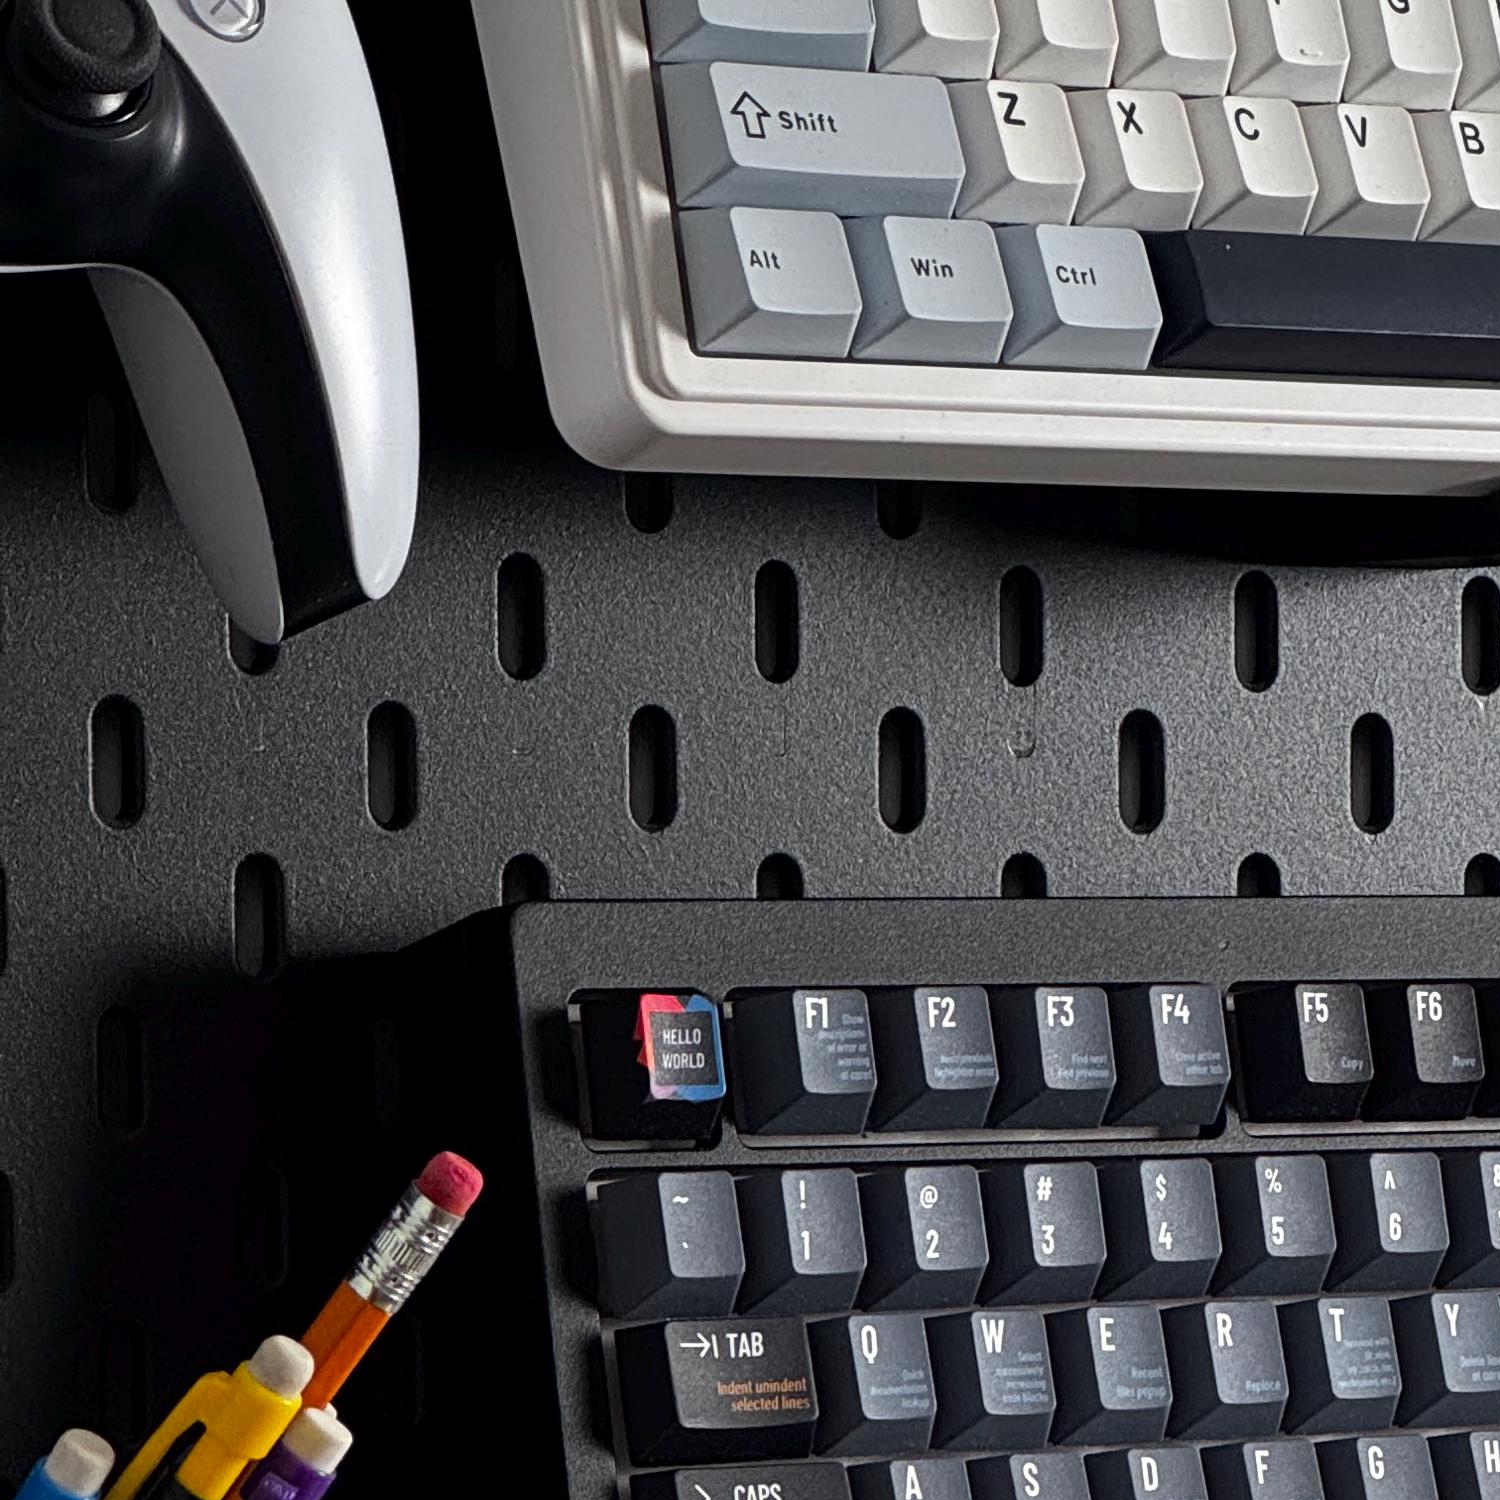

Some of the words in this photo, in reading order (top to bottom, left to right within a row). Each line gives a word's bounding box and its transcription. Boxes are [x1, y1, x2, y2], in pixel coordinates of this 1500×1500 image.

[779, 111, 837, 132] Shift
[998, 92, 1025, 125] Z
[1118, 102, 1143, 134] X
[1235, 108, 1259, 140] C
[1345, 115, 1366, 147] V
[1459, 122, 1484, 154] B
[750, 250, 780, 269] Alt
[911, 258, 953, 277] Win
[1056, 266, 1096, 285] Ctrl
[806, 998, 827, 1028] F1
[928, 997, 956, 1027] F2
[1048, 996, 1074, 1026] F3
[1162, 994, 1189, 1024] F4
[1303, 992, 1328, 1022] F5
[1417, 991, 1442, 1021] F6
[663, 1029, 700, 1044] HELLO
[663, 1054, 704, 1068] WORLD
[1042, 1225, 1054, 1254] 3
[1159, 1222, 1172, 1249] 4
[1272, 1216, 1284, 1244] 5
[1390, 1213, 1401, 1240] 6
[802, 1231, 809, 1260] 1
[926, 1230, 939, 1258] 2
[1100, 1318, 1115, 1351] E
[1217, 1313, 1233, 1346] R
[1329, 1308, 1344, 1341] T
[1445, 1304, 1458, 1336] Y
[726, 1332, 763, 1357] TAB
[862, 1325, 877, 1363] Q
[981, 1319, 1004, 1353] W
[718, 1380, 752, 1395] Indent
[756, 1378, 807, 1393] unindent
[731, 1396, 779, 1412] selected
[782, 1394, 810, 1410] lines
[1255, 1450, 1269, 1484] F
[1368, 1446, 1384, 1479] G
[1484, 1440, 1500, 1472] H
[906, 1466, 922, 1500] A
[1023, 1463, 1039, 1496] S
[1141, 1457, 1158, 1491] D
